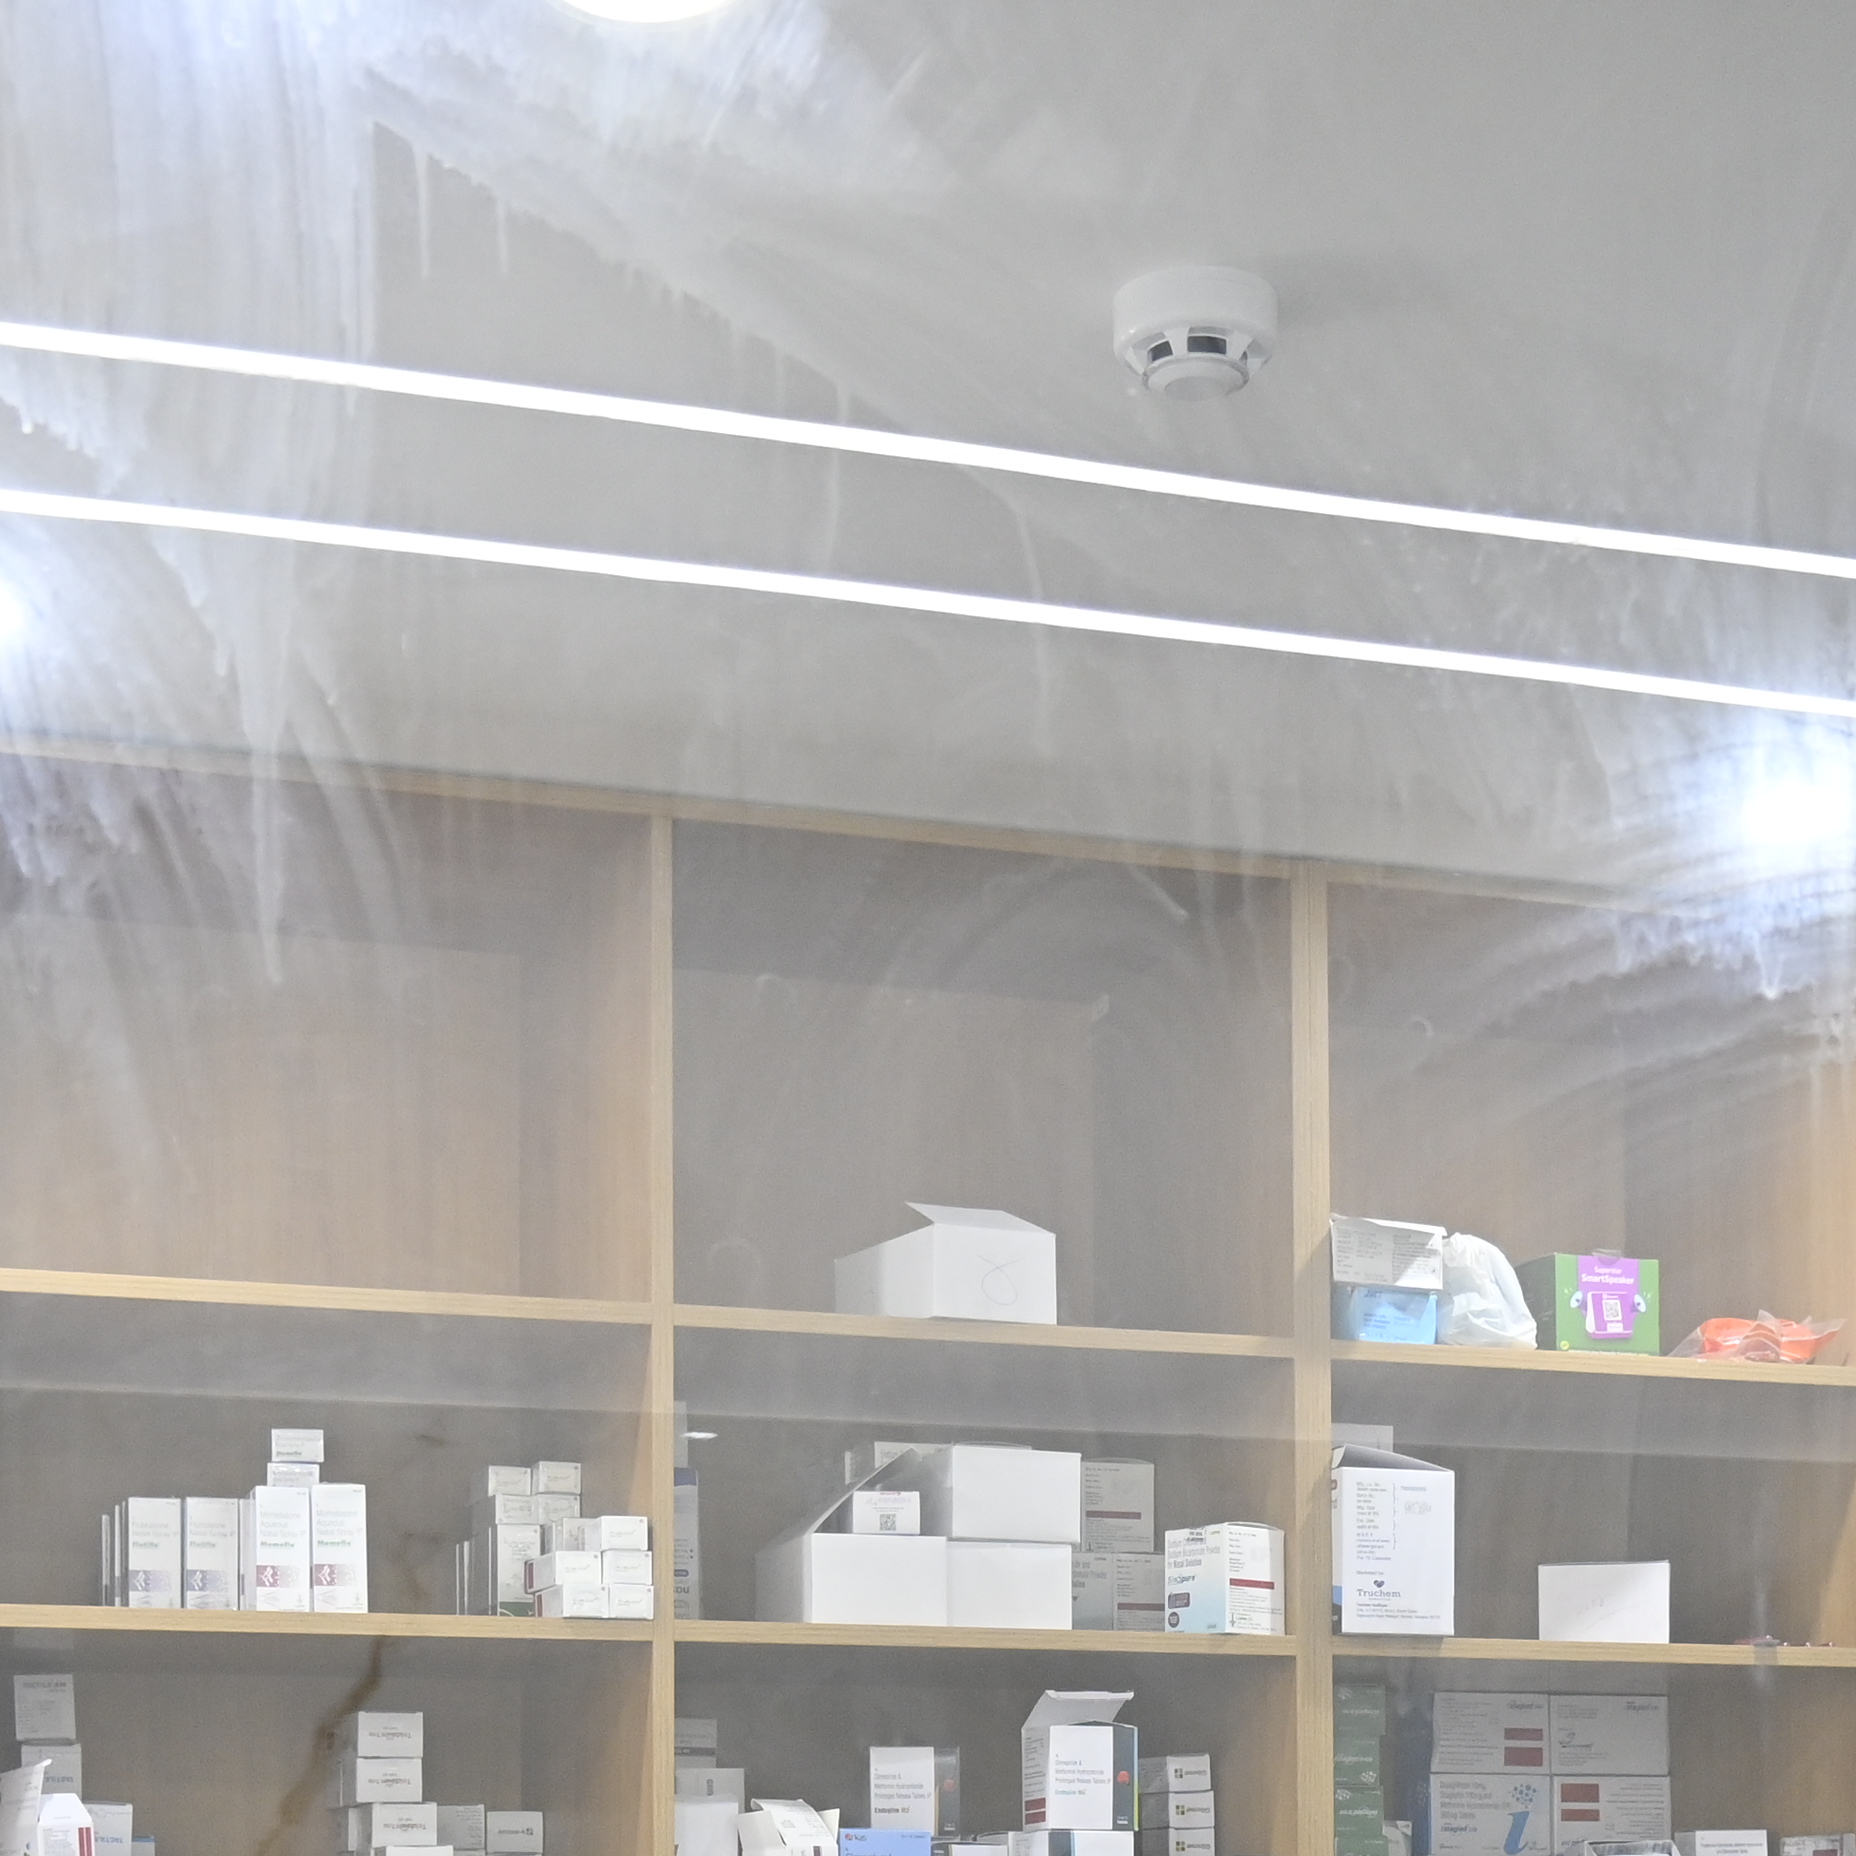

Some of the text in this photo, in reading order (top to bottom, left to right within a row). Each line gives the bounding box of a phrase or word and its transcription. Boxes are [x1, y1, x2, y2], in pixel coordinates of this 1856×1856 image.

[1594, 1266, 1622, 1275] Superstar
[1581, 1273, 1635, 1286] SmartSpeaker
[260, 1511, 301, 1520] Mometasone
[1357, 1589, 1401, 1598] Truchem
